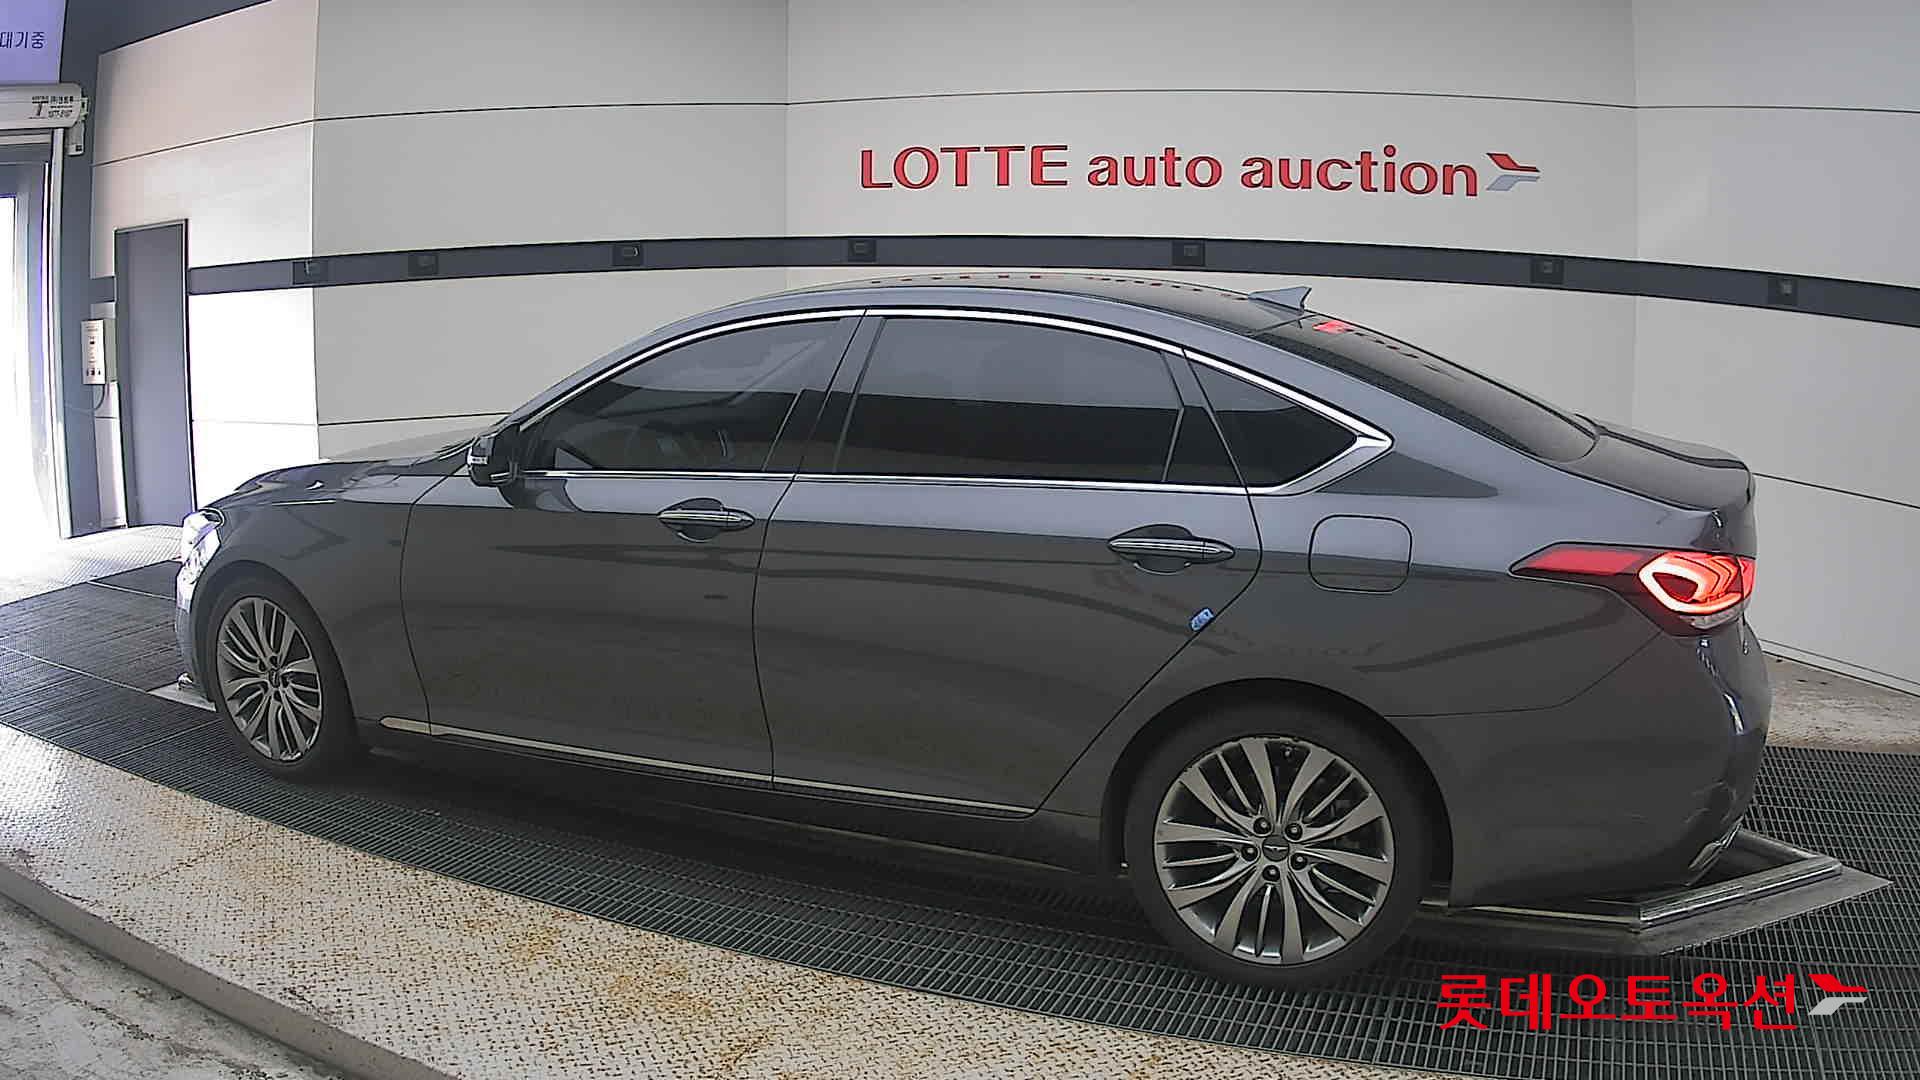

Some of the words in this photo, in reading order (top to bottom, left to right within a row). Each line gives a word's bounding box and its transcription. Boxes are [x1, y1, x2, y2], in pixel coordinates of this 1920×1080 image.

[860, 145, 1068, 190] LOTTE
[1087, 146, 1223, 188] auto
[1240, 144, 1479, 197] auction
